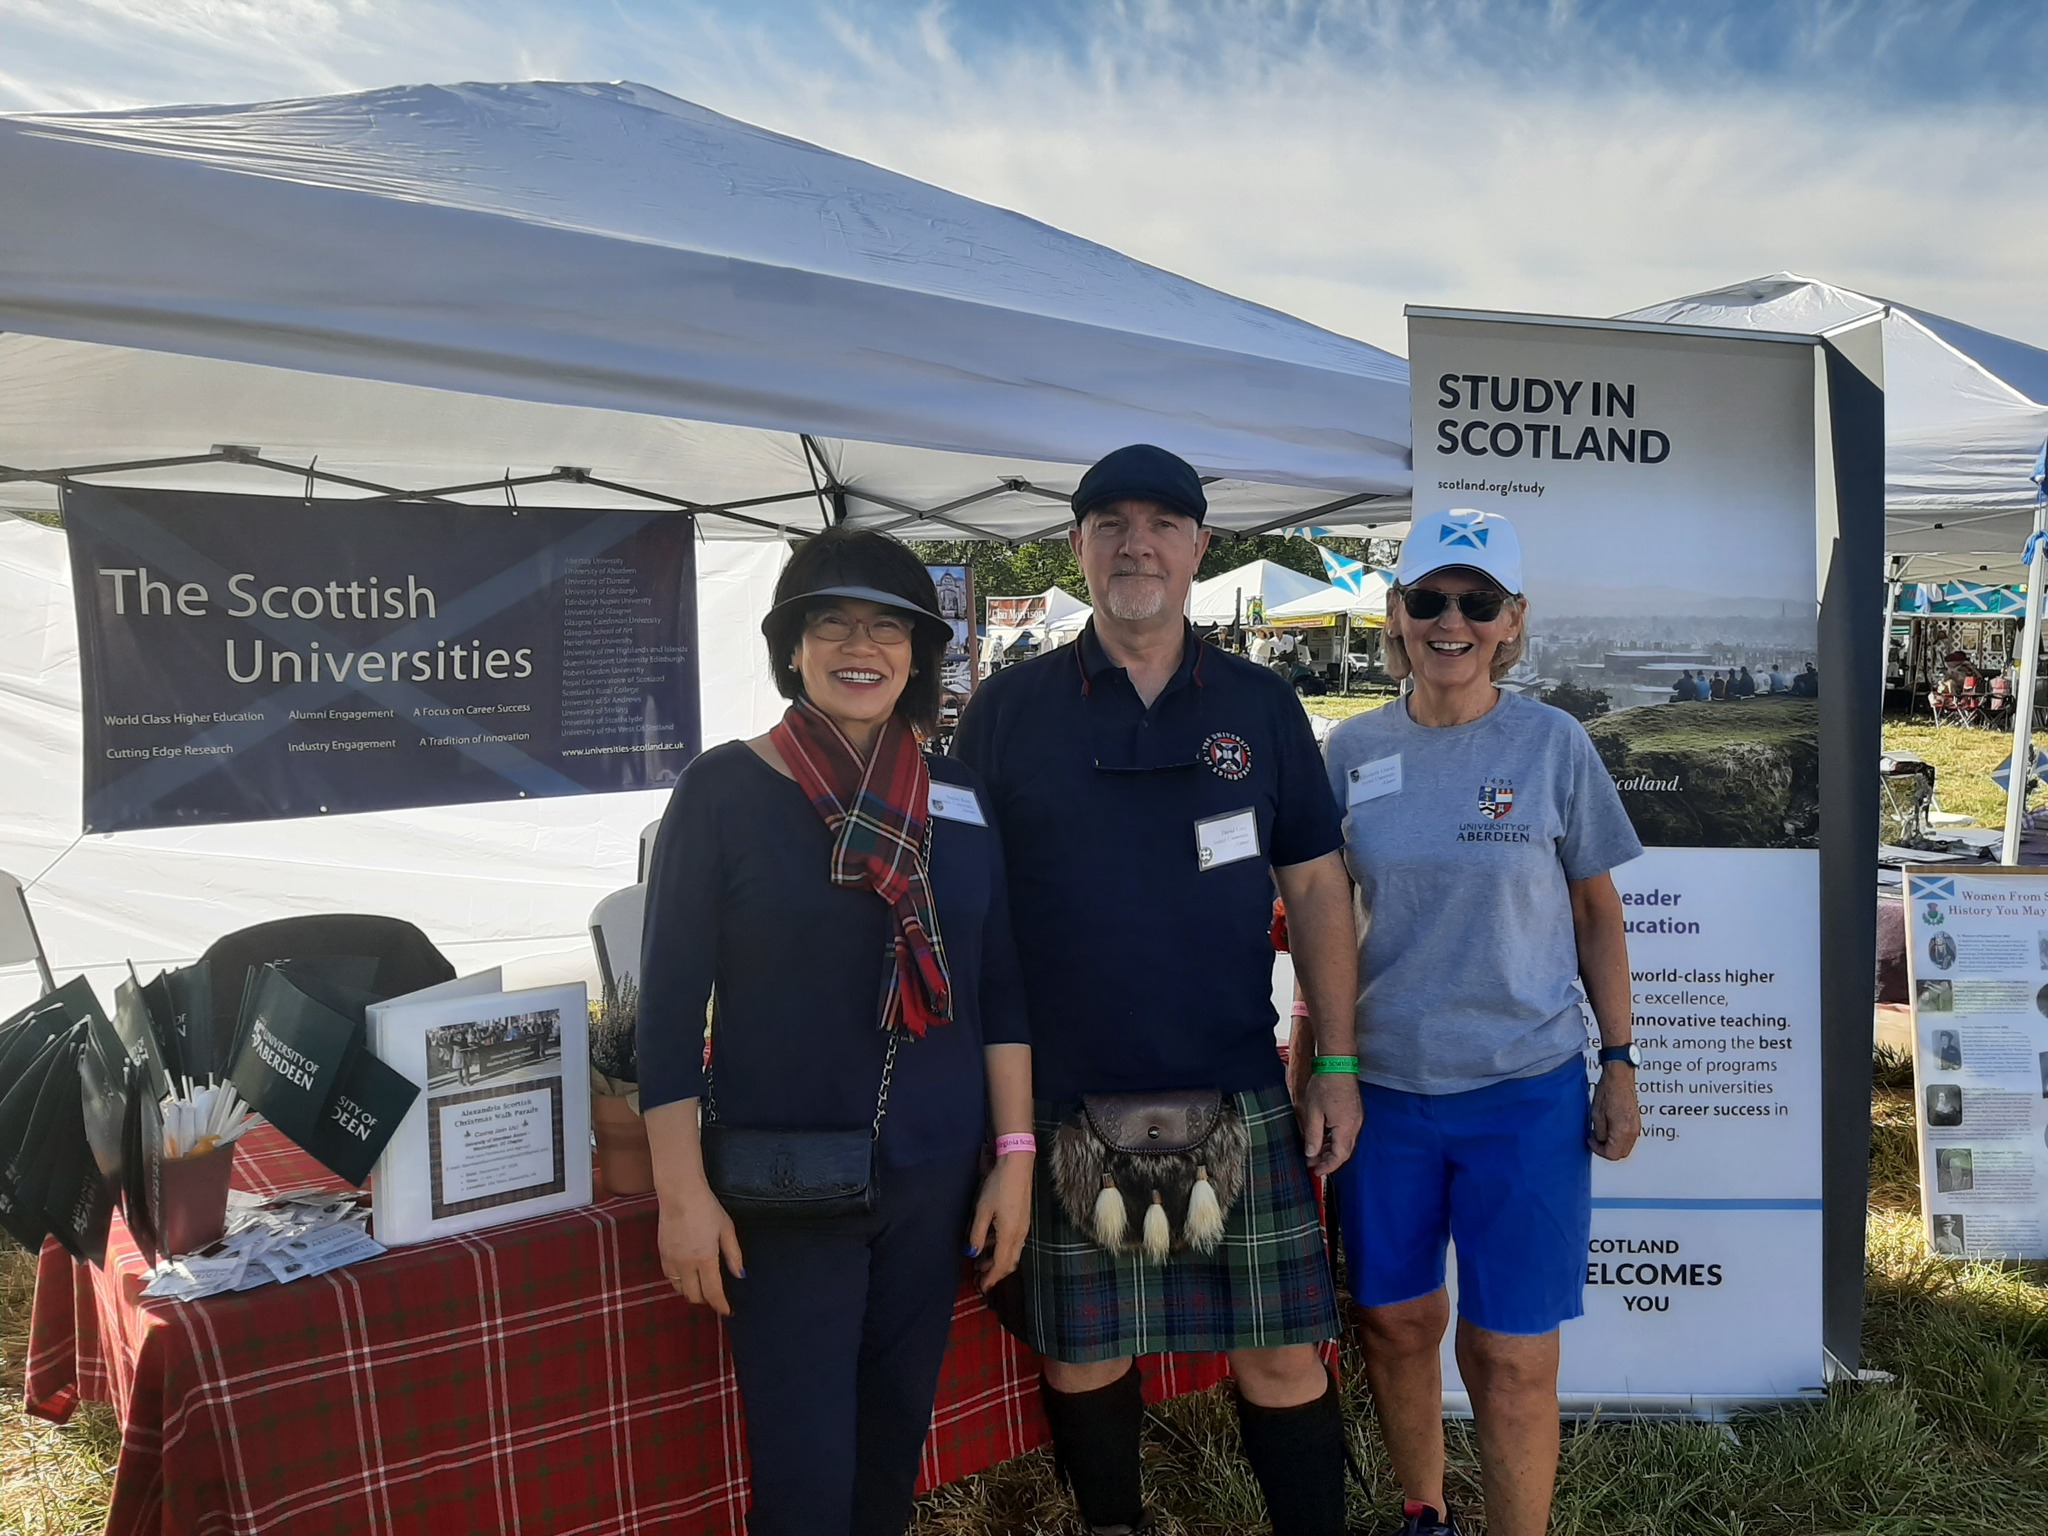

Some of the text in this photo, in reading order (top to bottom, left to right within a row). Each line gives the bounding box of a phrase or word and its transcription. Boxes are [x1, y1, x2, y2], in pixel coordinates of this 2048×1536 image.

[1437, 373, 1635, 418] STUDY IN
[1436, 418, 1671, 464] SCOTLAND
[1437, 478, 1545, 498] scotland.org/study
[99, 567, 436, 619] The Scottish
[1009, 608, 1046, 622] Morrison
[226, 639, 533, 684] Universities
[104, 711, 264, 726] World Class Higher Education
[289, 709, 394, 722] Alumni Engagement
[413, 703, 531, 717] A Focus on Career Success
[288, 739, 396, 753] Industry Engagement
[419, 732, 530, 746] A Tradition of Innovation
[1211, 732, 1252, 757] UNIVERSITY
[106, 743, 234, 760] Cutting Edge Research
[561, 742, 685, 757] www.universities-scotland.ac.uk
[1484, 777, 1513, 786] 1495
[1459, 823, 1532, 832] UNIVERSITY OF
[1456, 832, 1530, 843] ABERDEEN
[1621, 889, 1682, 906] eader
[1961, 890, 2006, 901] Women
[2009, 890, 2042, 901] From
[1948, 905, 2047, 918] History You May
[1624, 917, 1700, 934] ucation
[1631, 969, 1775, 986] world-class higher
[1645, 991, 1728, 1007] excellence,
[1631, 1013, 1791, 1031] innovative teaching.
[262, 1029, 320, 1075] UNIVERSITY OF
[1634, 1035, 1793, 1053] rank among the best
[256, 1041, 314, 1091] ABERDEEN
[1686, 1057, 1704, 1071] of
[1706, 1060, 1778, 1075] programs
[1689, 1079, 1774, 1095] universities
[461, 1099, 532, 1117] Alexandria Scottish
[1638, 1102, 1789, 1117] or career success in
[331, 1106, 372, 1141] DEEN
[360, 1112, 378, 1127] OF
[454, 1116, 492, 1128] Christmas
[514, 1106, 538, 1117] Parade
[474, 1129, 494, 1138] Come
[1641, 1123, 1679, 1142] ving.
[1588, 1239, 1679, 1254] COTLAND
[1586, 1262, 1723, 1286] ELCOMES
[1622, 1296, 1670, 1312] YOU
